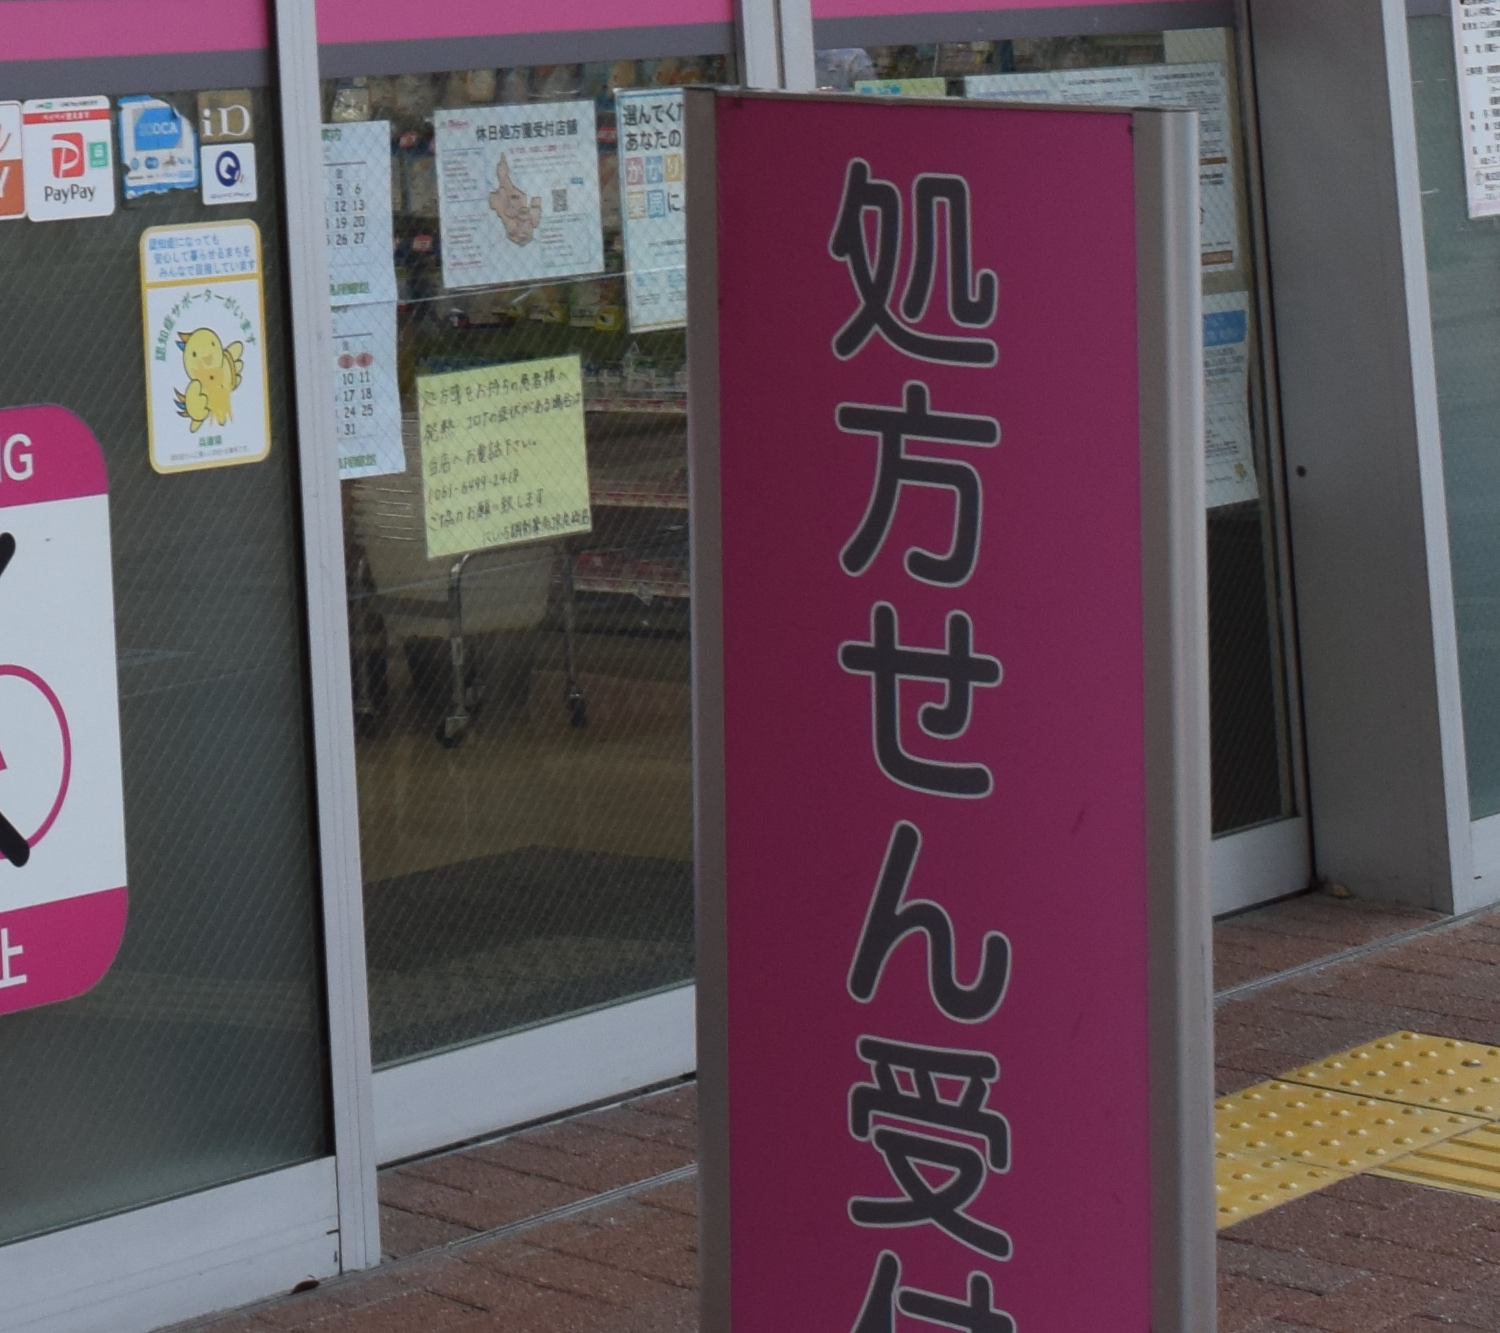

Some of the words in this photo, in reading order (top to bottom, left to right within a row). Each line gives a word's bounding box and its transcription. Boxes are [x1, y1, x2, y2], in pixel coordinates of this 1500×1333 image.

[202, 104, 250, 136] iD
[625, 129, 681, 151] あなたの
[44, 184, 96, 205] PayPay
[334, 200, 347, 212] 12
[352, 199, 365, 212] 13
[335, 217, 348, 229] 19
[353, 216, 366, 228] 20
[336, 234, 349, 246] 26
[353, 233, 366, 245] 27
[342, 372, 354, 385] 10
[343, 389, 355, 402] 17
[344, 404, 356, 417] 24
[344, 422, 356, 435] 31
